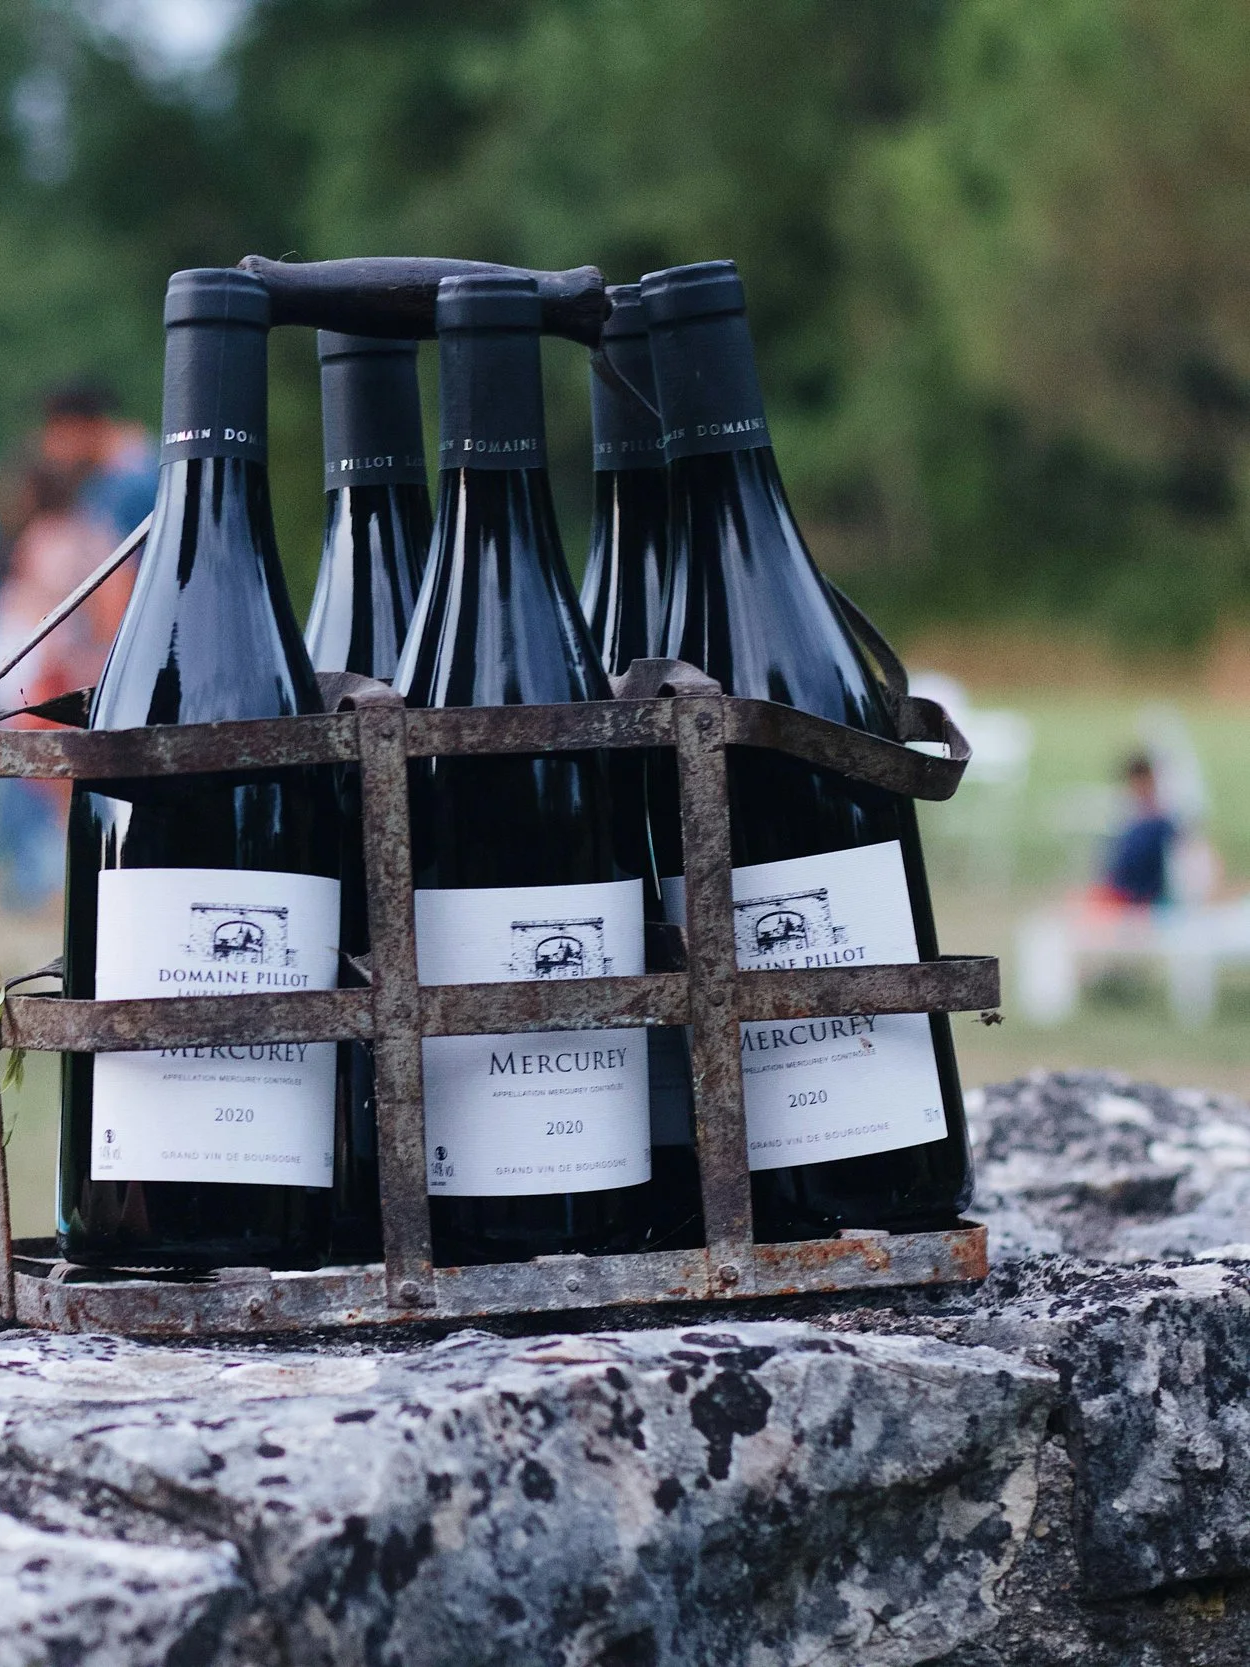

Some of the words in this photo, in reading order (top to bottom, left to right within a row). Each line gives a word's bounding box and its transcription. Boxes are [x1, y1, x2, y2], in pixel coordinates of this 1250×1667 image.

[463, 438, 538, 453] DOMAINE
[340, 456, 395, 471] PILLOT
[805, 946, 866, 968] PILLOT
[159, 969, 249, 985] DOMAINE
[257, 972, 310, 987] PILLOT
[488, 1047, 628, 1075] MERCUREY
[787, 1089, 828, 1108] 2020
[215, 1107, 255, 1122] 2020
[545, 1120, 584, 1136] 2020
[750, 1139, 782, 1150] GRAND
[786, 1136, 803, 1146] VIN
[807, 1133, 820, 1143] DE
[824, 1122, 890, 1141] BOURGOGNE
[161, 1151, 199, 1160] GRAND
[204, 1151, 222, 1160] VIN
[227, 1152, 239, 1162] DE
[244, 1152, 302, 1164] BOURGOGNE
[496, 1166, 534, 1176] GRAND
[538, 1165, 555, 1174] VIN
[559, 1163, 571, 1173] DE
[575, 1158, 628, 1172] BOURGOGNE
